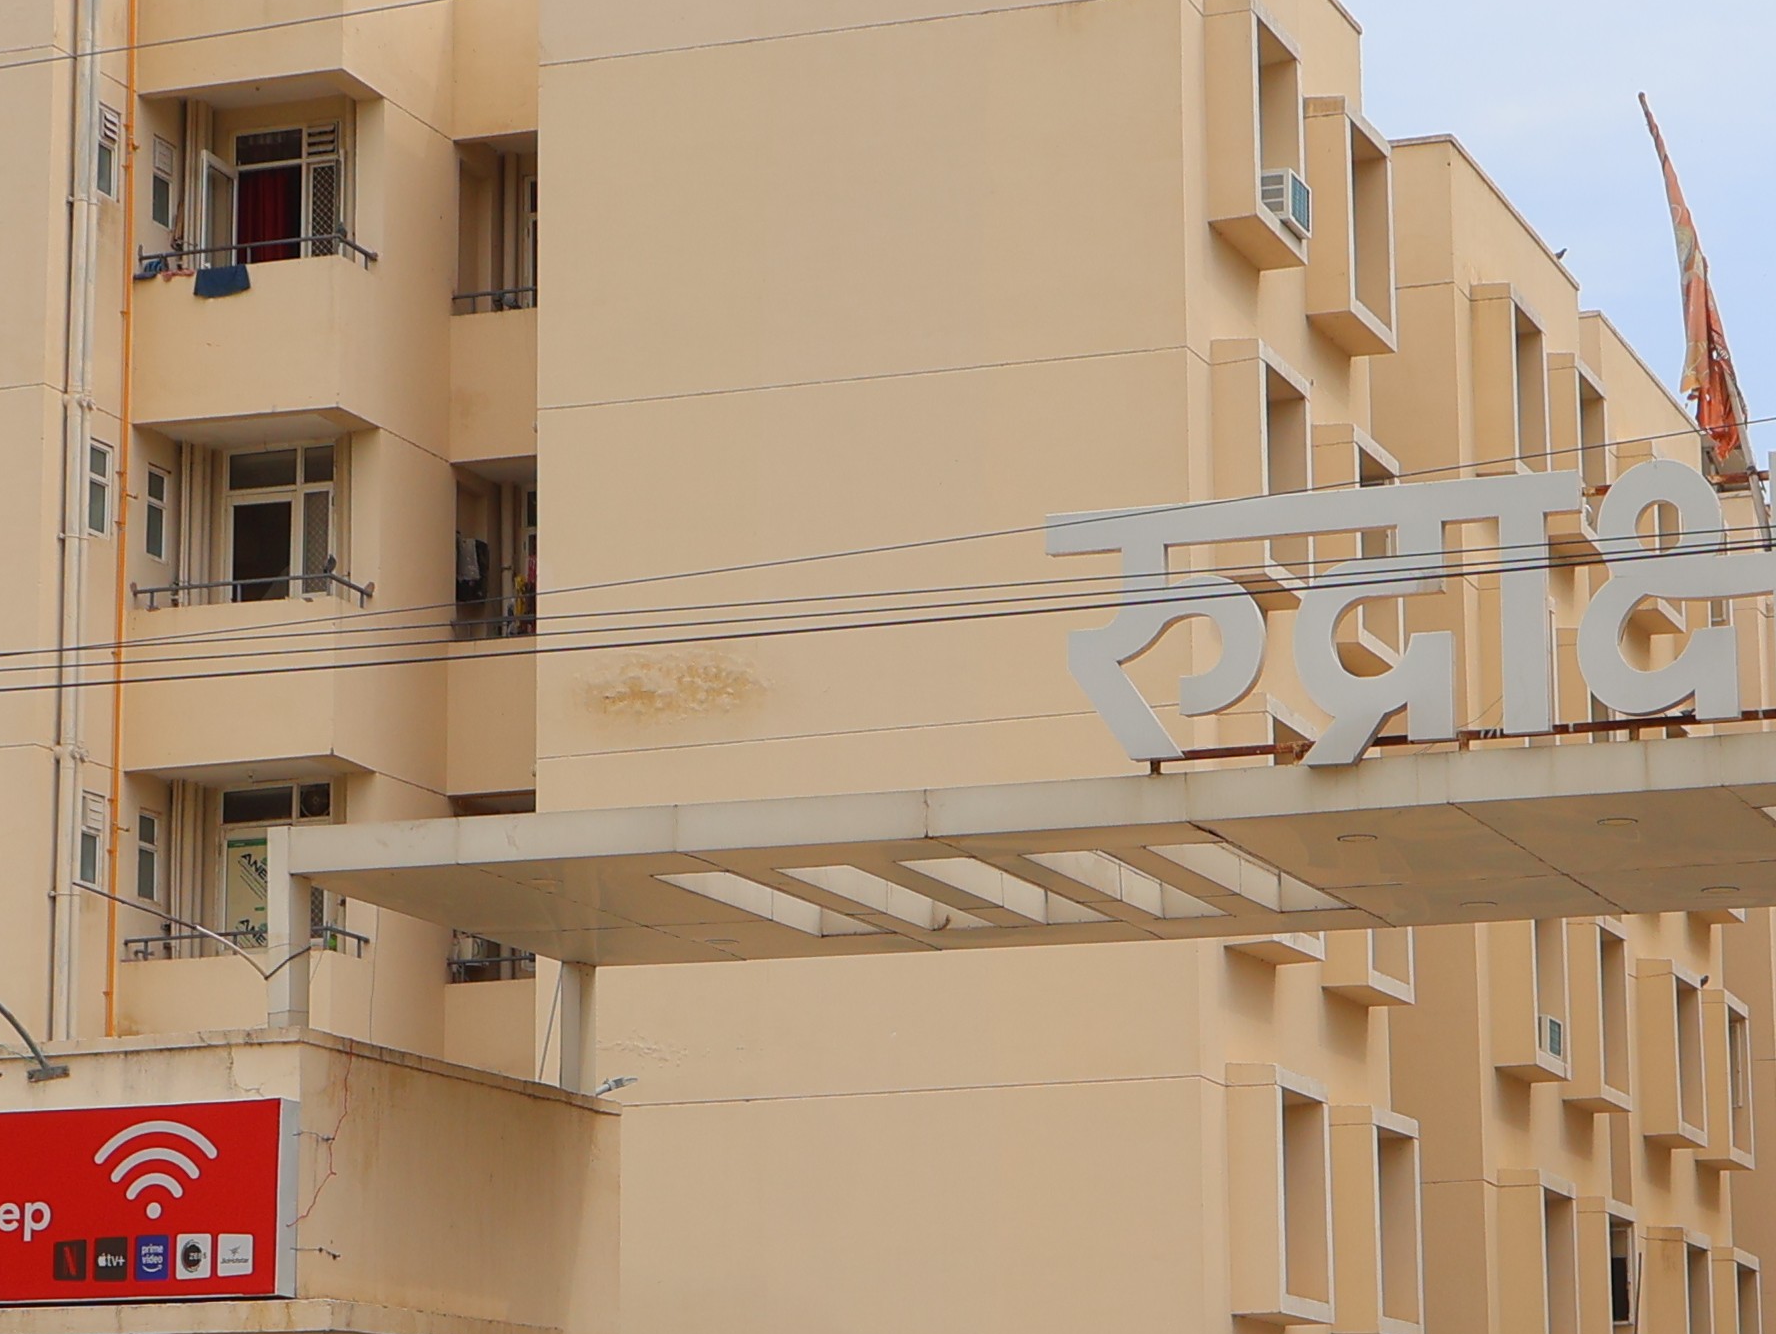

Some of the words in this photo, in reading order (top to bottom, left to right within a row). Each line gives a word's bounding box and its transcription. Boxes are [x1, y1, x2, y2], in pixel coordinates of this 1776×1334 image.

[239, 853, 268, 884] ANE
[141, 1243, 164, 1255] prime
[141, 1253, 164, 1265] video
